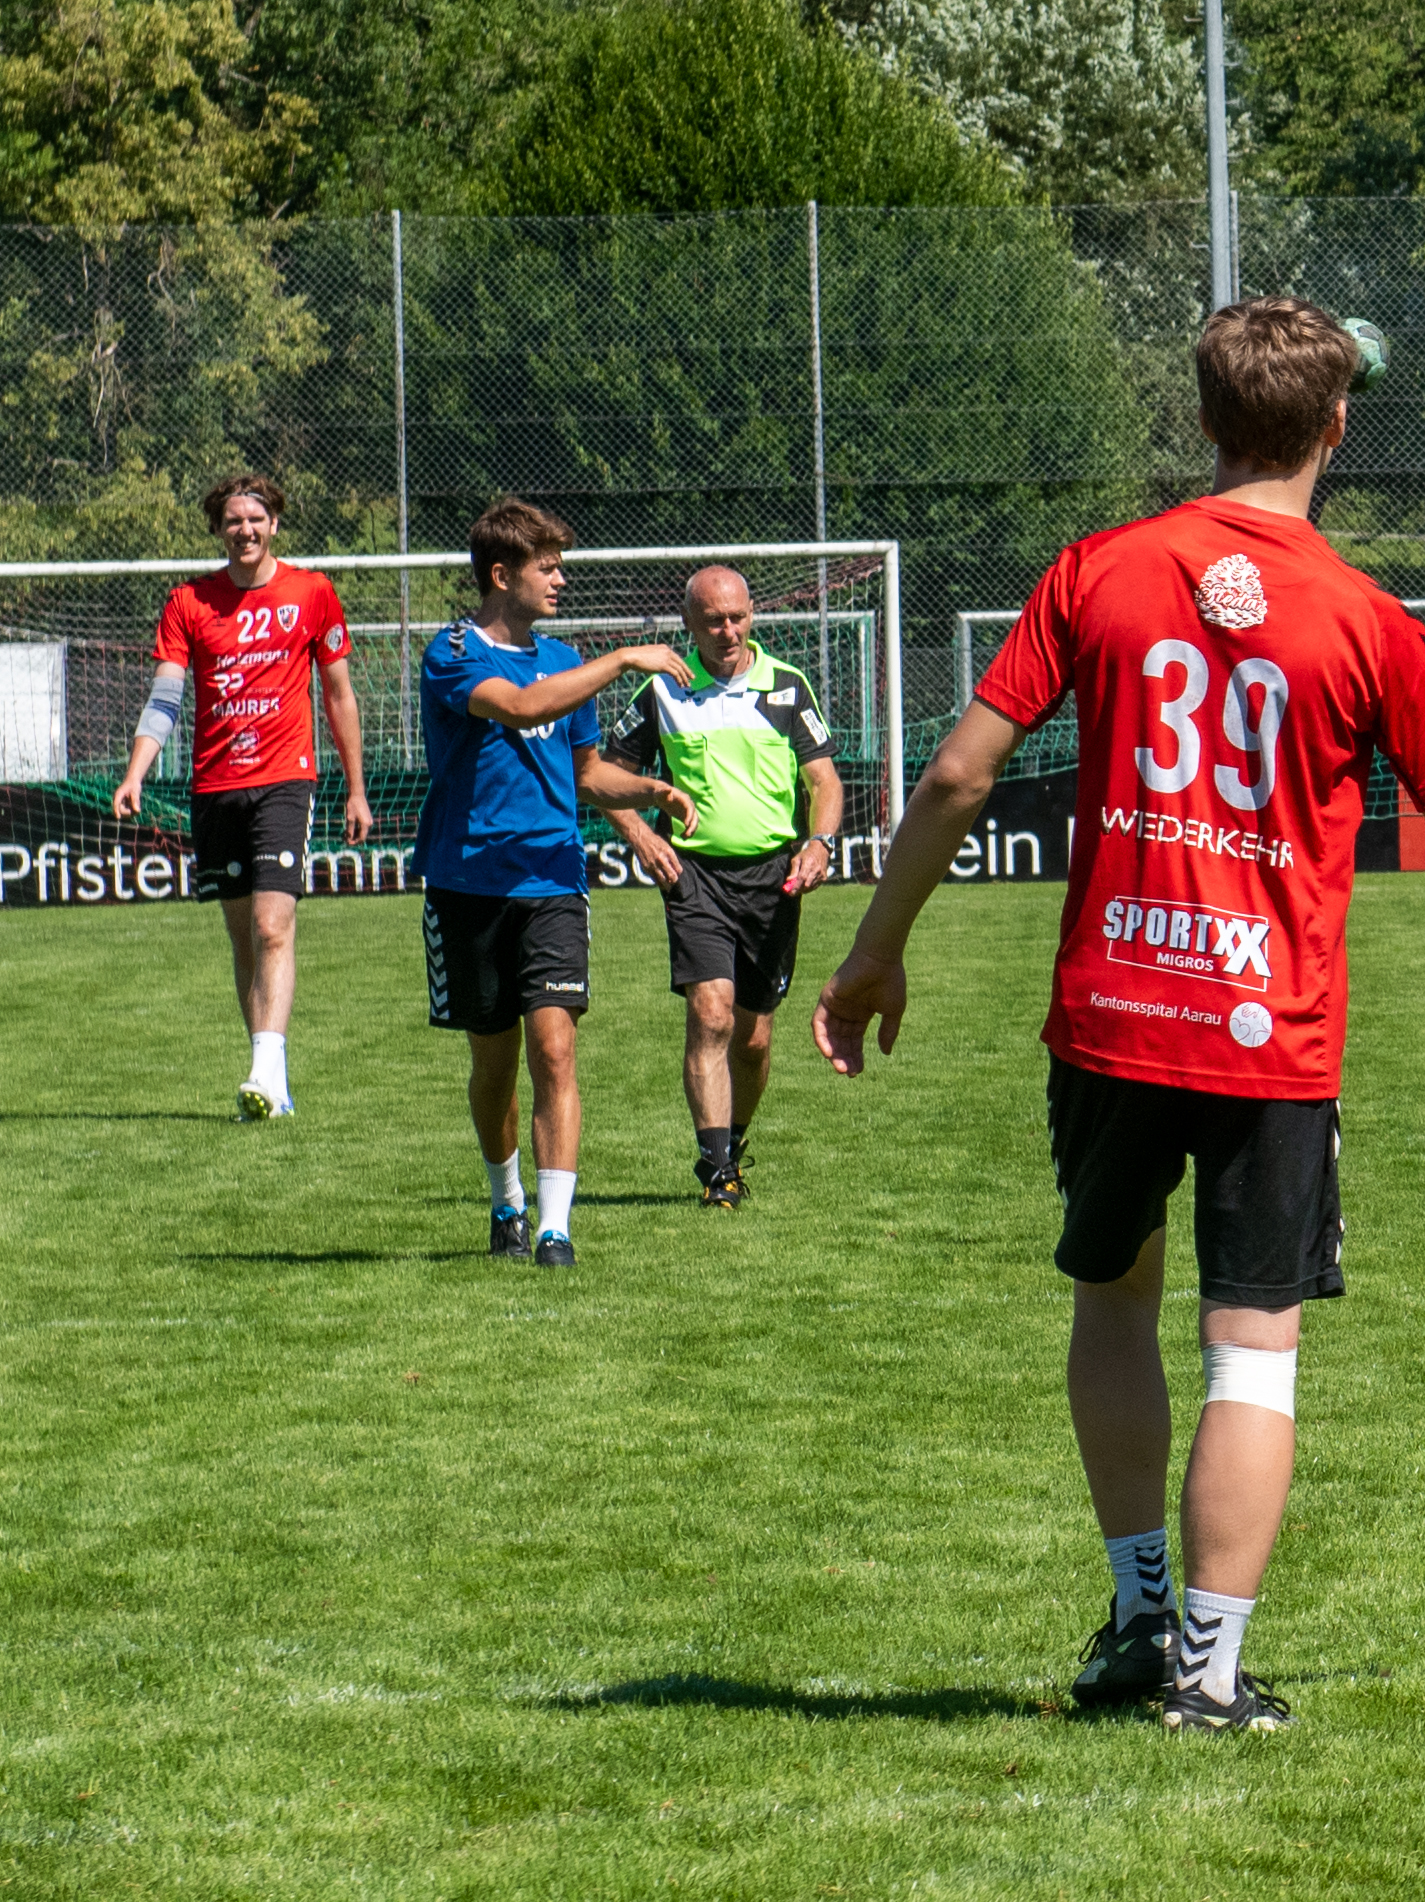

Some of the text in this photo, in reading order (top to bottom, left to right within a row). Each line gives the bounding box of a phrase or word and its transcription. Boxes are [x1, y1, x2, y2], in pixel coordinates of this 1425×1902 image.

[237, 607, 272, 644] 22
[1134, 638, 1290, 811] 39
[1101, 806, 1295, 870] WIEDERKEHR
[0, 842, 197, 902] Pfister
[1156, 952, 1215, 972] MIGROS
[1090, 991, 1222, 1026] Kantonsspital Aarau
